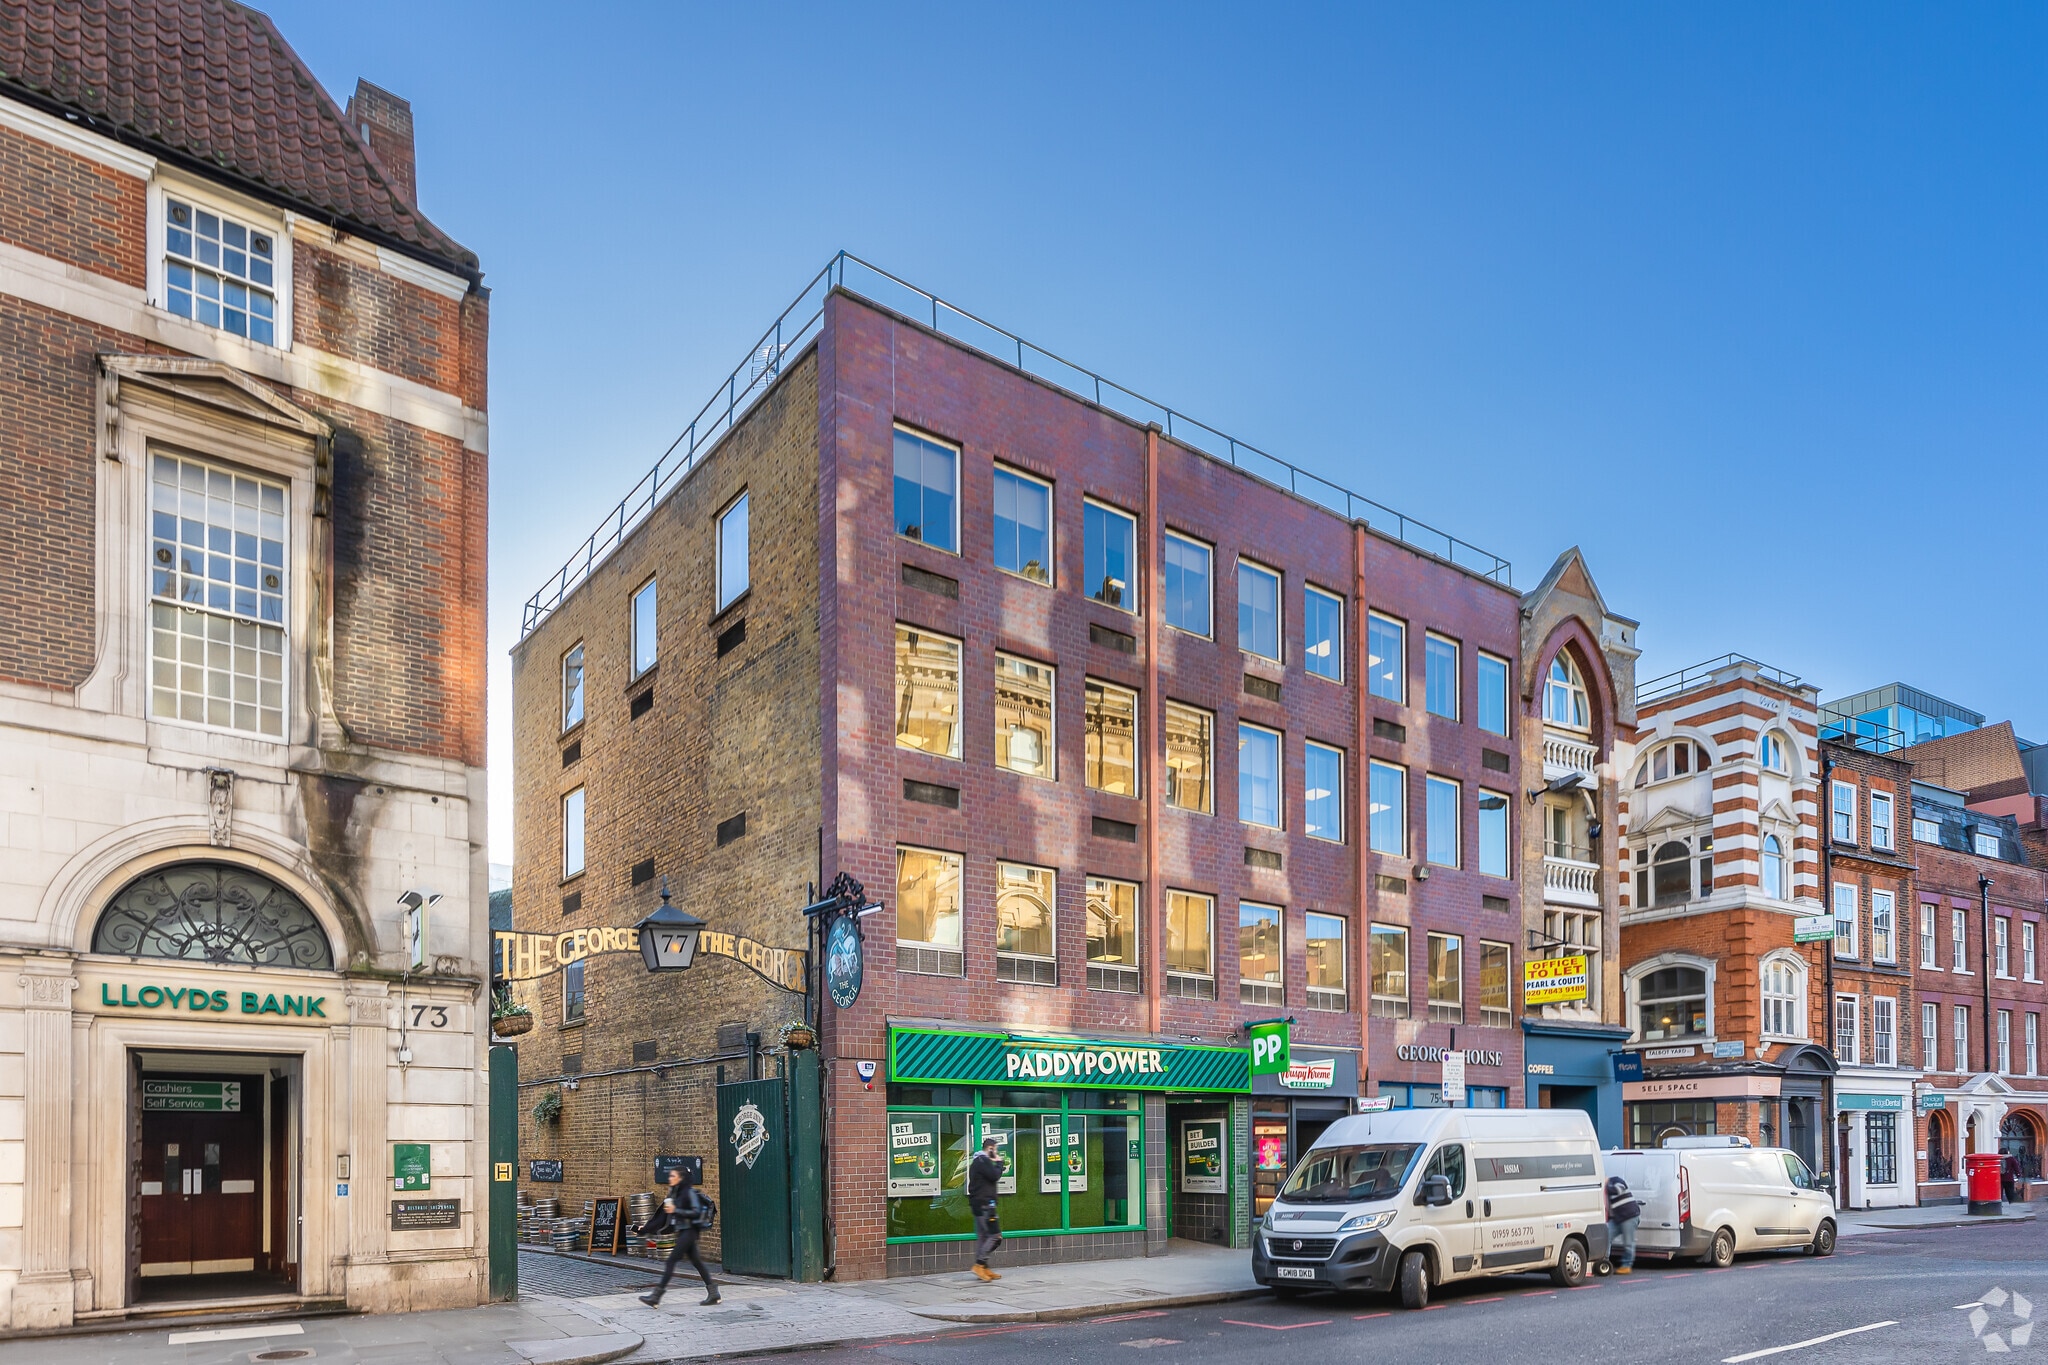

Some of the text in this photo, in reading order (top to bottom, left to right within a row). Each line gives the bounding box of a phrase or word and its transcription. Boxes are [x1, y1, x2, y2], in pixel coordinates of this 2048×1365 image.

[661, 934, 694, 954] 77
[495, 927, 640, 981] THE GEORGE
[700, 931, 807, 993] THE GEORGE
[1532, 957, 1578, 970] OFFICE
[1528, 965, 1583, 979] TO LET
[839, 980, 849, 990] THE
[1526, 976, 1585, 989] PEARL & COUTTS
[831, 984, 858, 1007] GEORGE
[1543, 987, 1563, 995] 7843
[1565, 984, 1585, 993] 9189
[102, 982, 327, 1018] LLOYDS BANK
[411, 1005, 449, 1028] 73
[1397, 1044, 1504, 1067] GEORG HOUSE
[1308, 1065, 1332, 1081] Kreme
[1528, 1064, 1554, 1075] COFFEE
[146, 1083, 193, 1094] Cashiers
[1642, 1083, 1698, 1093] SELF SPACE
[146, 1098, 205, 1109] Self Service
[736, 1111, 753, 1126] GEORGE
[895, 1125, 910, 1134] BET
[1048, 1125, 1060, 1134] BET
[1189, 1131, 1201, 1139] BET
[896, 1135, 929, 1146] BUILDER
[1049, 1135, 1077, 1146] BUIER
[1190, 1140, 1215, 1149] BUILDER
[497, 1164, 510, 1179] H
[1491, 1226, 1534, 1240] 01959 563 770
